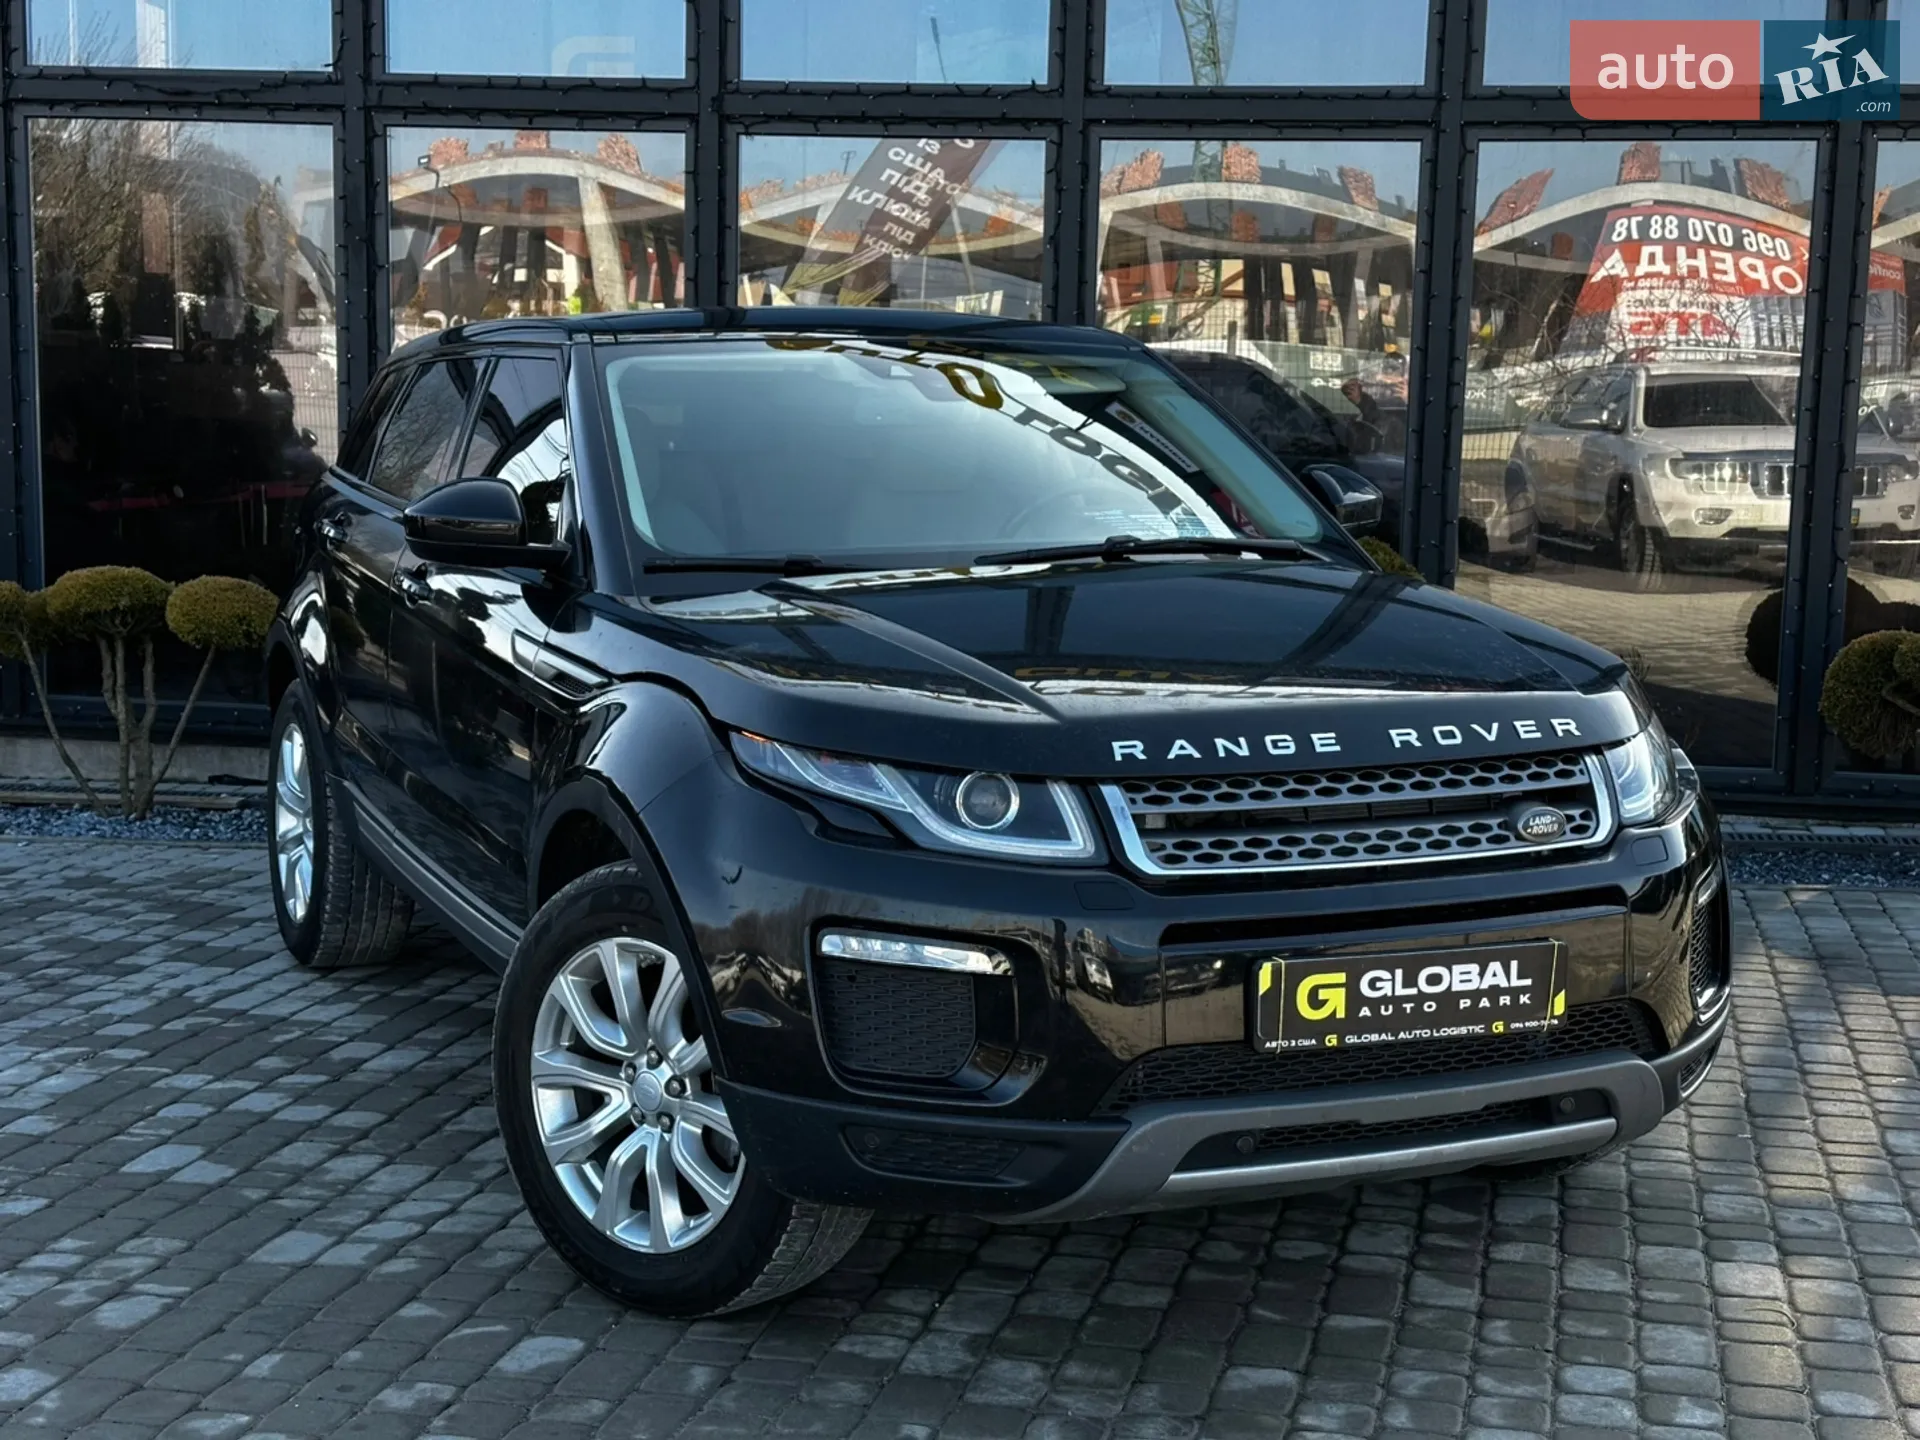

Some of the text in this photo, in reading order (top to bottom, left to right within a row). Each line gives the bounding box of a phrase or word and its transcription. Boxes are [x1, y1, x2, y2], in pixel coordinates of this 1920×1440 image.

[888, 147, 945, 181] США
[880, 168, 929, 195] ПІД
[1111, 718, 1582, 762] RANGE ROVER
[1530, 815, 1551, 826] LAND
[1532, 823, 1558, 834] ROVER
[1359, 960, 1532, 998] GLOBAL
[1359, 993, 1531, 1017] AUTO PARK
[1345, 1024, 1485, 1044] GLOBAL AUTO LOGISTIC
